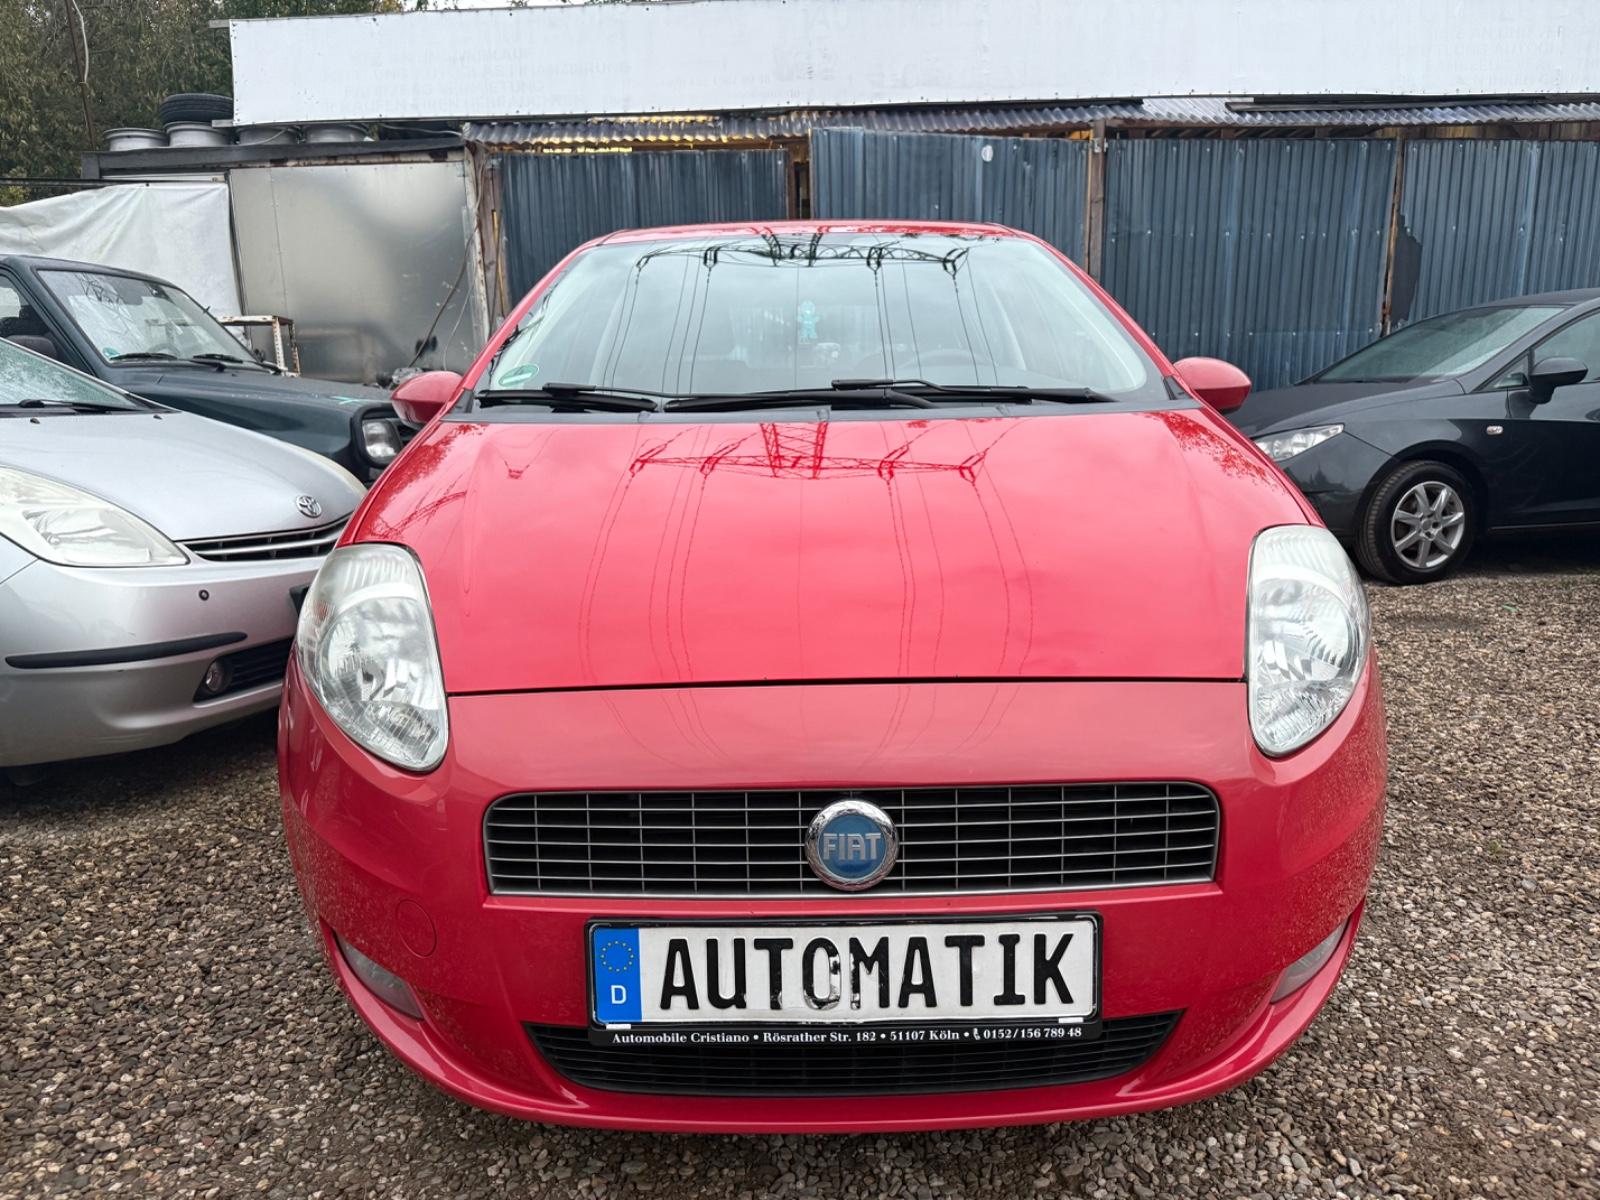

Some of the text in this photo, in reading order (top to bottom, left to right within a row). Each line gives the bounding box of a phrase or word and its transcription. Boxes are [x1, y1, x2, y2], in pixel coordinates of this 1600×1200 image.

[823, 833, 881, 860] FIAT
[660, 933, 1074, 1010] AUTOMATIK
[610, 984, 627, 1005] D
[612, 1032, 688, 1044] Automobile
[690, 1032, 750, 1043] Cristiano
[763, 1031, 827, 1043] Rösrather
[829, 1031, 852, 1043] Str.
[855, 1031, 877, 1042] 182
[890, 1030, 926, 1042] 51107
[929, 1029, 960, 1041] Köln
[1044, 1027, 1065, 1039] 789
[1067, 1027, 1082, 1037] 48
